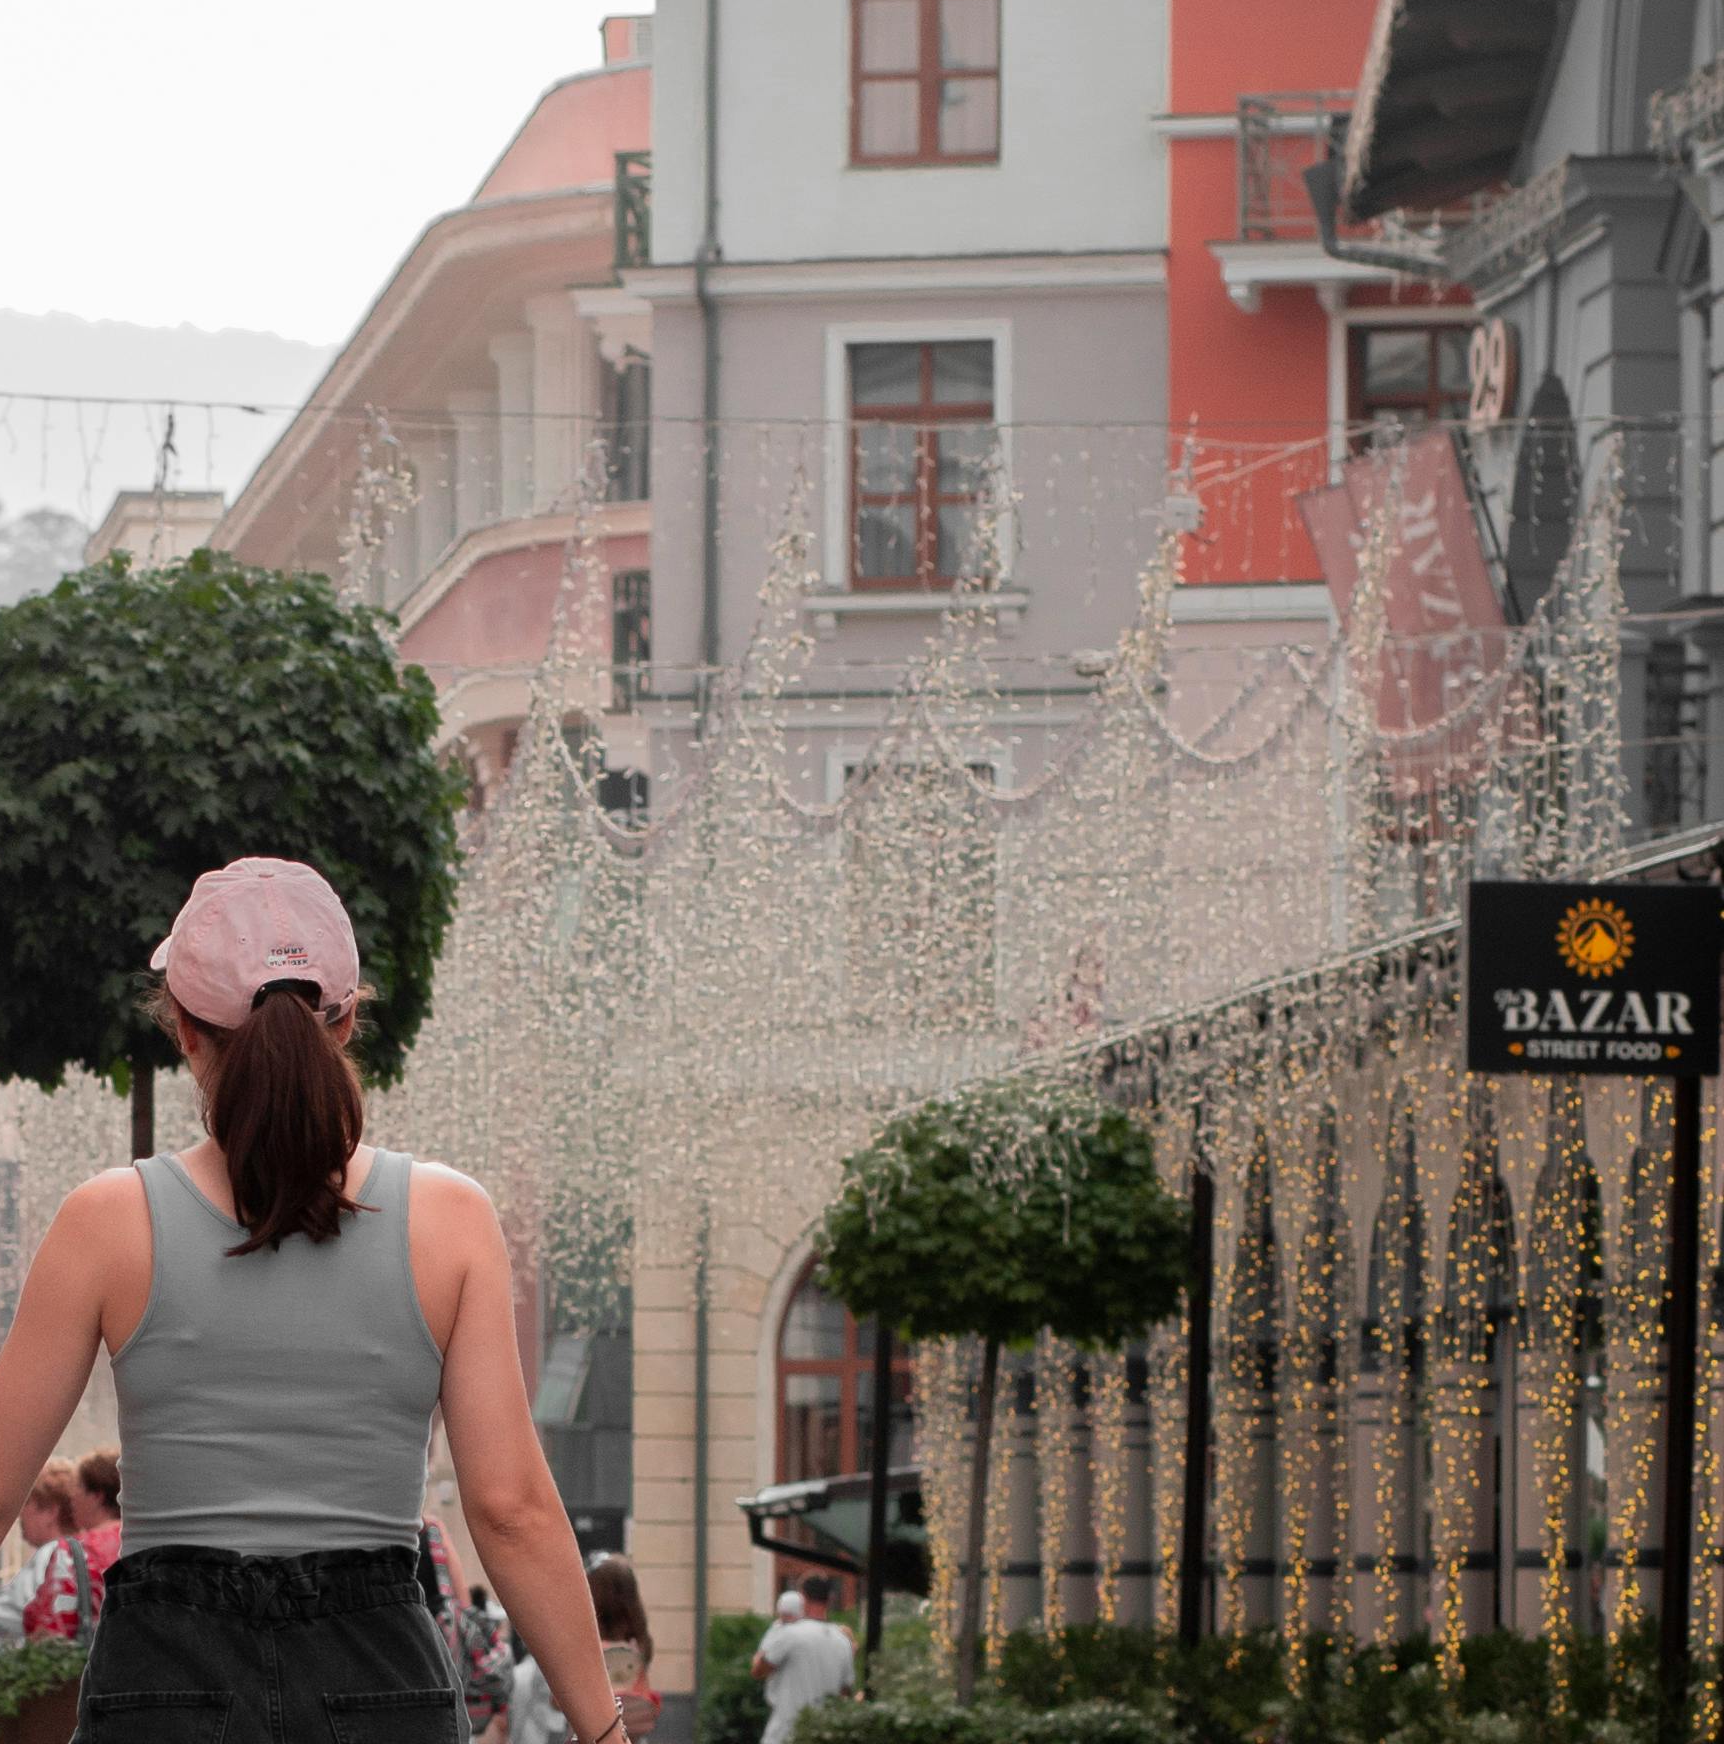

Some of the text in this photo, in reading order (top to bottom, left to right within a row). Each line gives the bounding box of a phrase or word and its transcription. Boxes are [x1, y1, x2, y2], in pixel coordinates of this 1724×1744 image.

[1467, 318, 1506, 431] 29
[271, 947, 304, 955] TOMMY
[1502, 988, 1694, 1035] BAZAR
[1526, 1039, 1662, 1061] STREET FOOD
